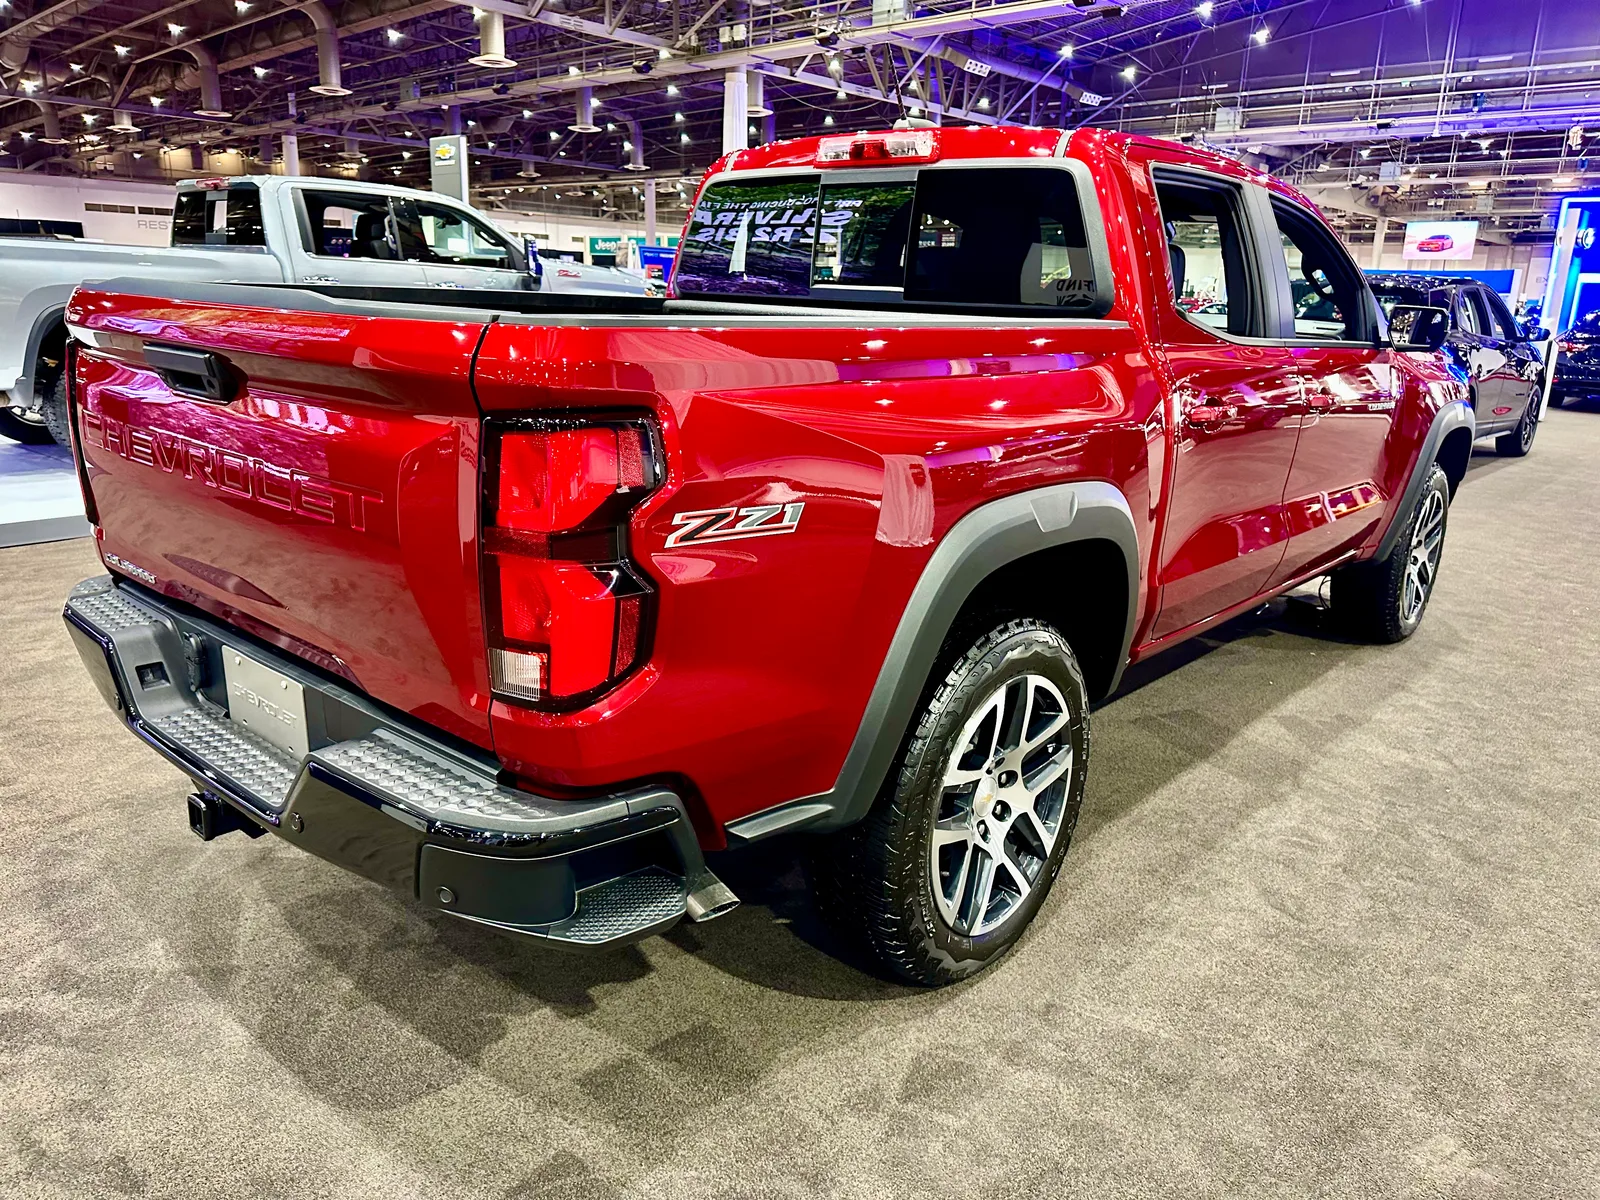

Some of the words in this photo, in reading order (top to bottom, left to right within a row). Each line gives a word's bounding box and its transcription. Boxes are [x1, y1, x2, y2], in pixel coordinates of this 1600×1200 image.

[595, 239, 617, 252] Jeep
[82, 408, 384, 532] CHEVROLET
[664, 492, 806, 548] Z71
